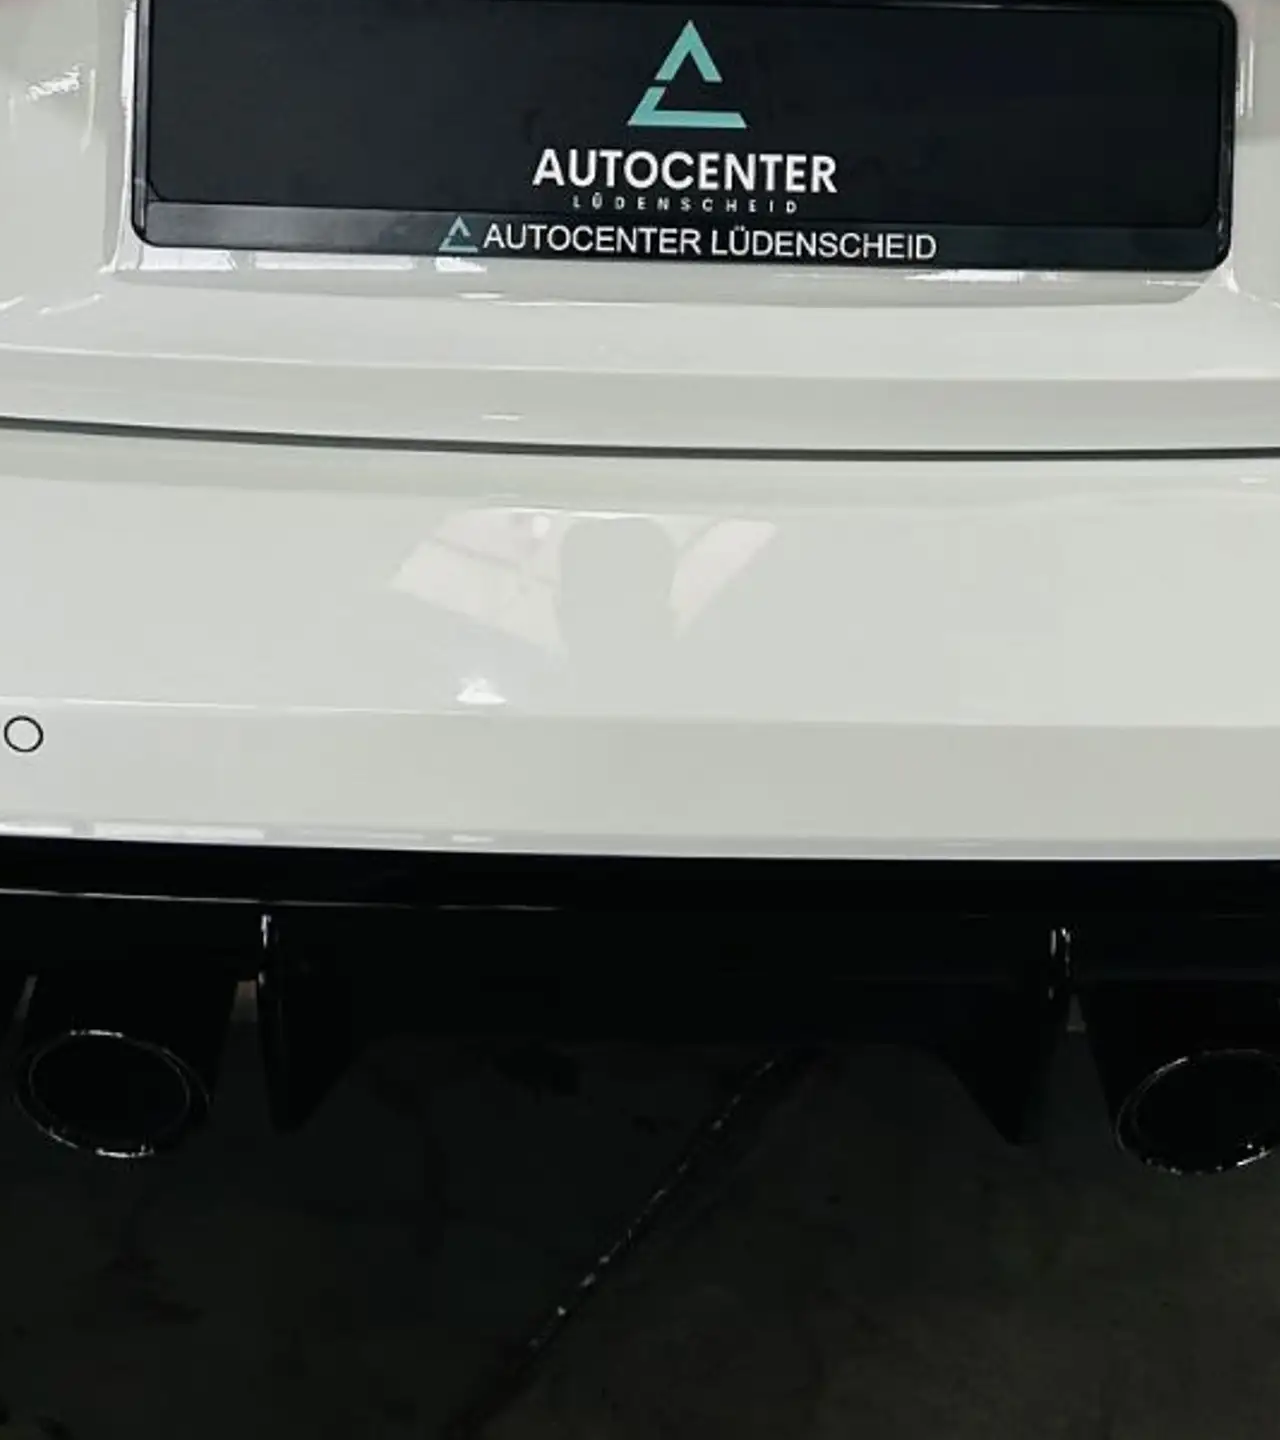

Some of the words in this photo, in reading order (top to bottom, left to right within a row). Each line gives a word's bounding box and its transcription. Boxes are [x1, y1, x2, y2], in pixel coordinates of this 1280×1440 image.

[532, 148, 838, 194] AUTOCENTER
[571, 193, 800, 214] LÜDENSCHEID
[483, 217, 702, 256] AUTOCENTER
[711, 219, 937, 260] LÜDENSCHEID
